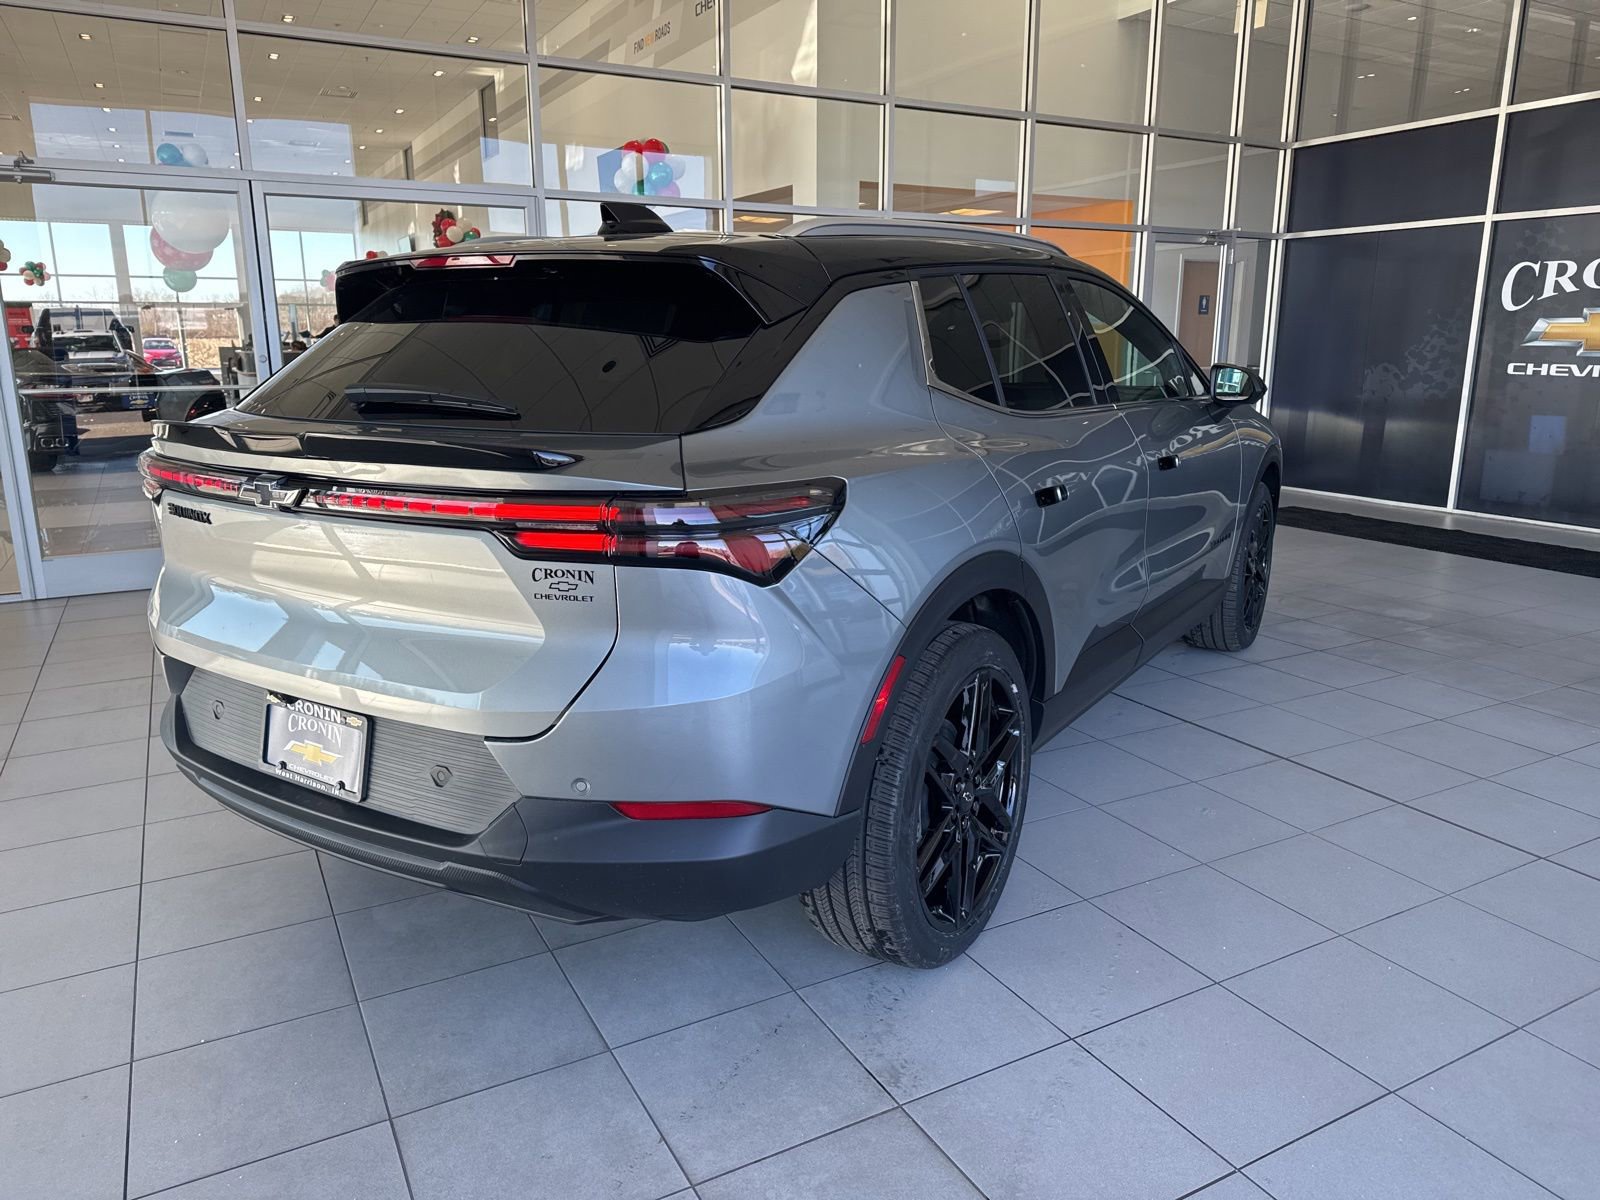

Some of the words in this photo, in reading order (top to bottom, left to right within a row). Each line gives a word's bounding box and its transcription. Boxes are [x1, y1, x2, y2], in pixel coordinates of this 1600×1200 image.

[695, 0, 715, 16] CHE
[531, 567, 594, 584] CRONIN
[534, 592, 594, 602] CHEVROLET
[288, 713, 342, 749] CRONIN
[275, 767, 293, 779] West
[288, 763, 335, 782] CHEVROLET
